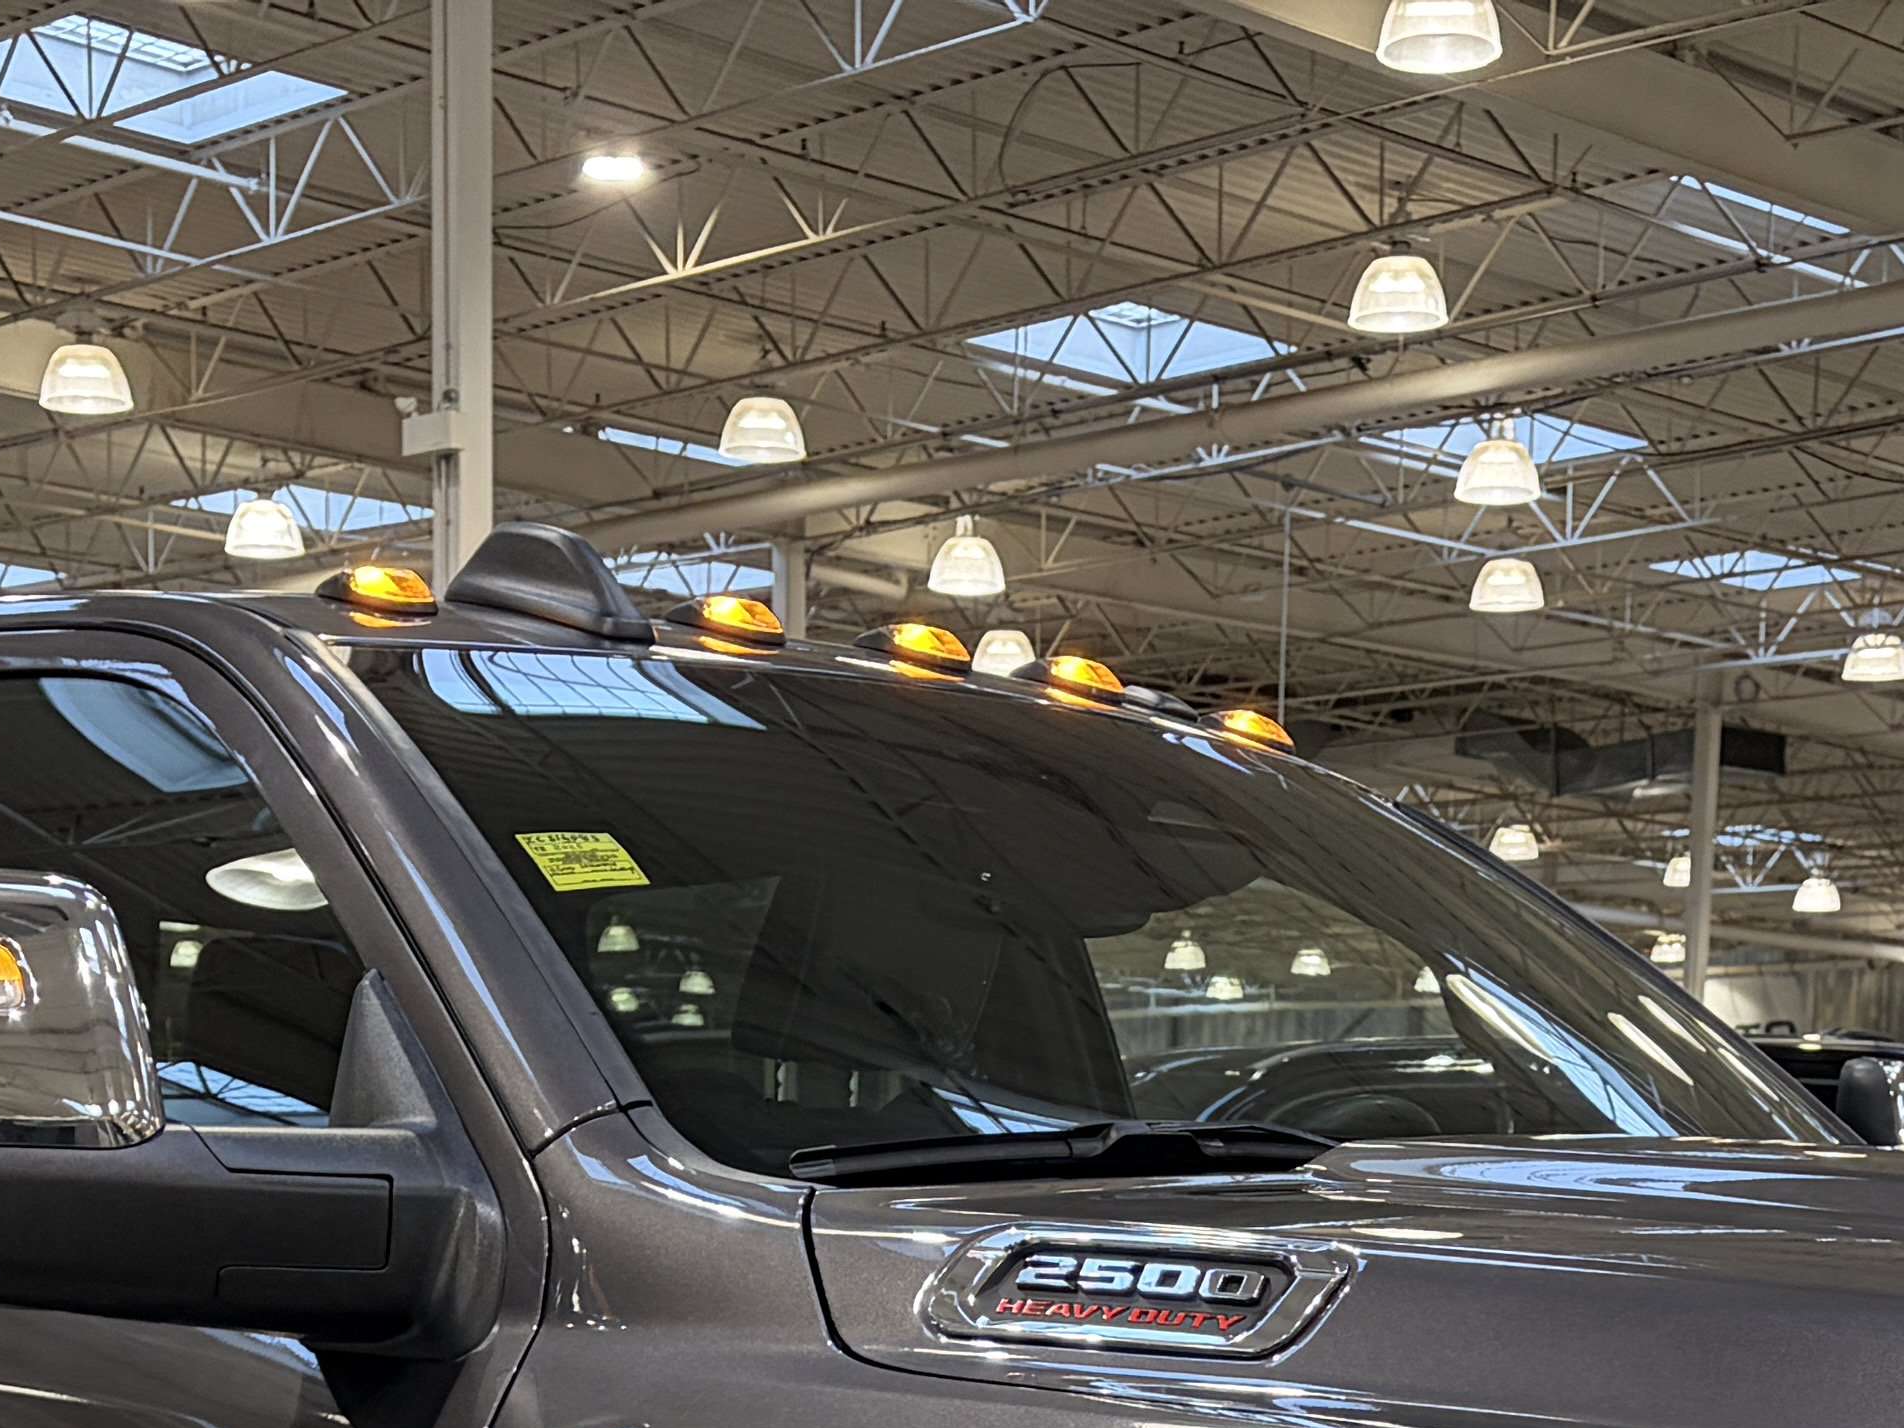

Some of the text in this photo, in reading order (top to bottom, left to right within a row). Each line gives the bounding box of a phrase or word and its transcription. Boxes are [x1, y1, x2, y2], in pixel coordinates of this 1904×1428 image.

[1015, 1254, 1269, 1305] 2500
[995, 1297, 1247, 1332] HEAVY DUTY
